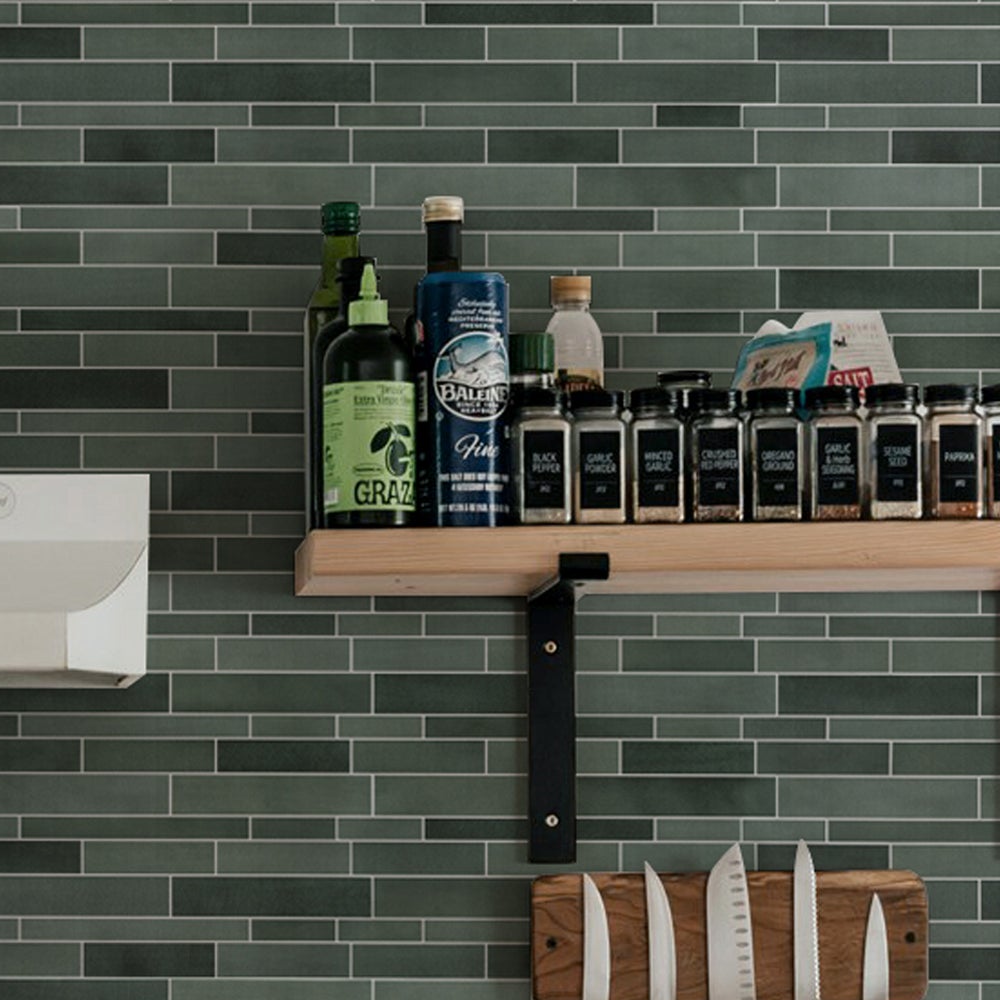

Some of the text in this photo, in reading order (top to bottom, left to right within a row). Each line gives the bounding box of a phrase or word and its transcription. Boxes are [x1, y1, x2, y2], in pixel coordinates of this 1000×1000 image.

[439, 383, 508, 402] BALEINE
[454, 433, 499, 460] Fine
[824, 443, 851, 454] GARLIC
[883, 446, 912, 457] SESAME
[532, 452, 557, 462] BLACK
[644, 451, 674, 461] MINCED
[701, 449, 737, 460] CRUSHED
[761, 450, 795, 461] OREGANO
[944, 451, 975, 462] PAPRIKA
[762, 461, 795, 471] GROUND
[888, 457, 908, 467] SEED
[532, 463, 560, 473] PEPPER
[584, 463, 616, 474] POWDER
[354, 479, 415, 506] GRAZ
